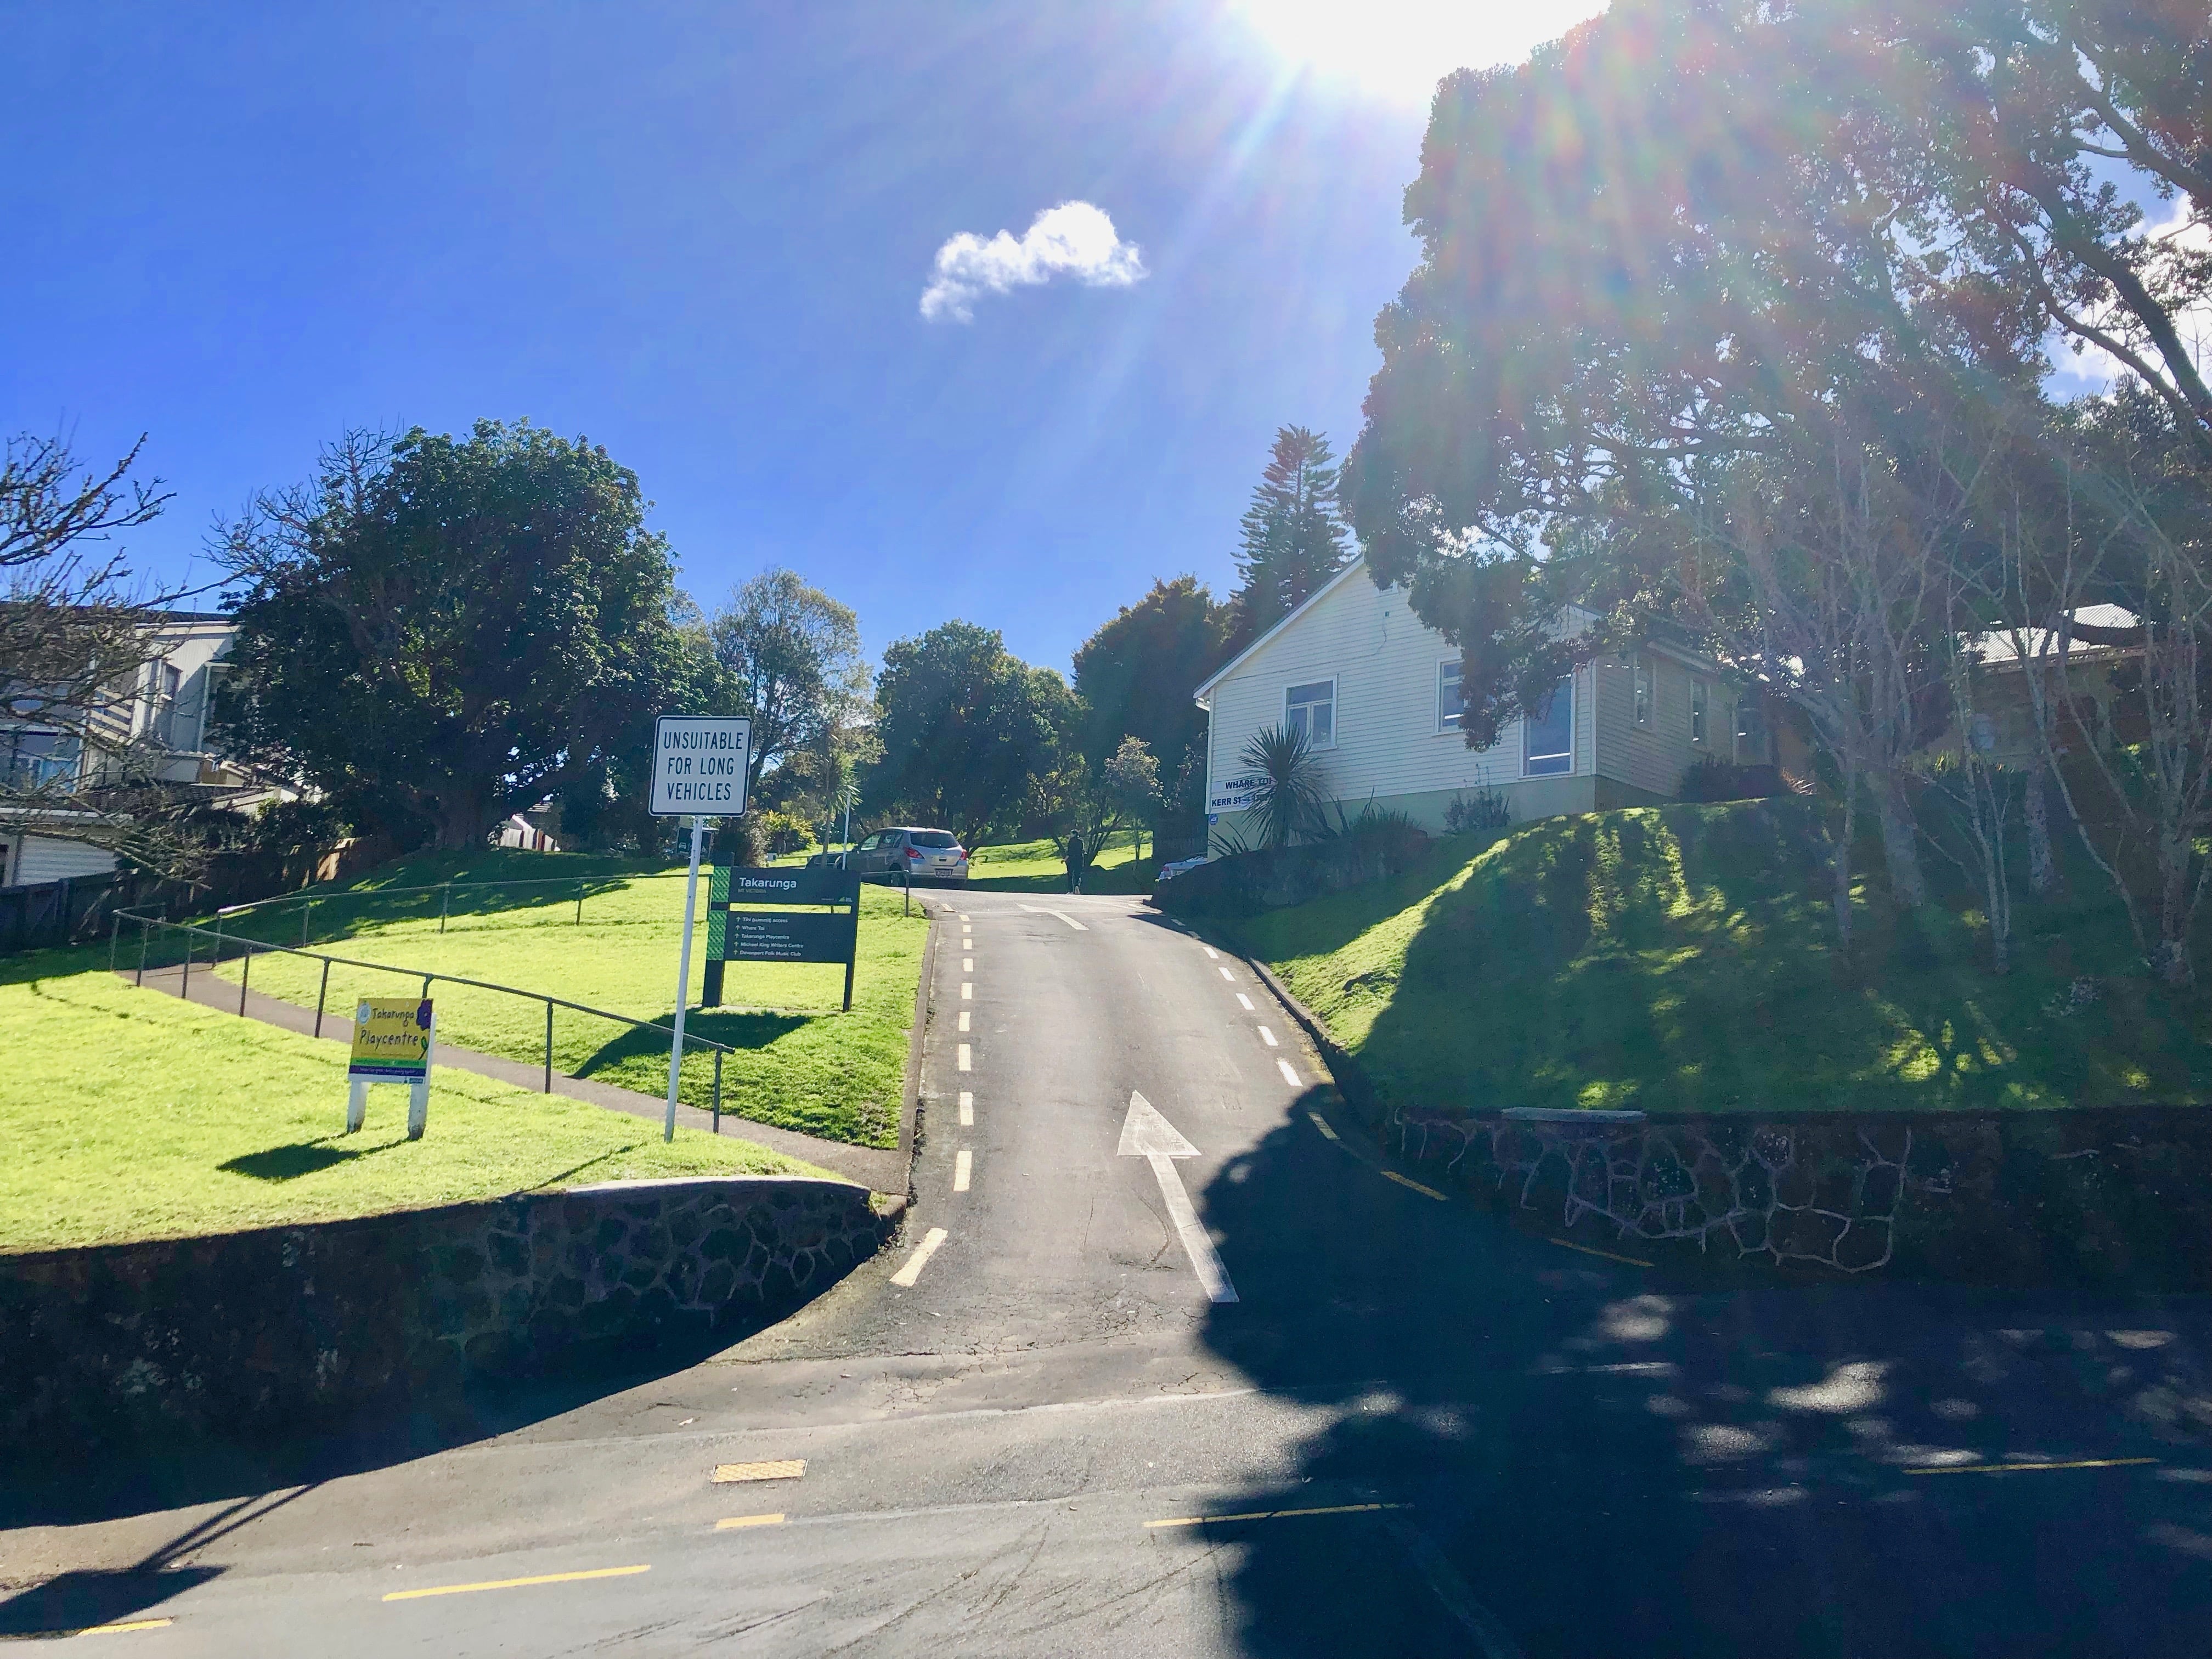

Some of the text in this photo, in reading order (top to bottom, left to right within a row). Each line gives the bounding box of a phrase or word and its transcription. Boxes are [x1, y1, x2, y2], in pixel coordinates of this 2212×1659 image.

[664, 731, 743, 749] UNSUITABLE
[668, 757, 734, 775] FOR LONG
[667, 782, 731, 800] VEHICLES
[1226, 779, 1255, 789] WHARE
[1211, 798, 1232, 806] KERR
[1233, 796, 1242, 804] ST
[739, 877, 797, 890] Takarunga
[373, 1008, 414, 1027] Takarunga
[359, 1029, 418, 1051] Playcentre
